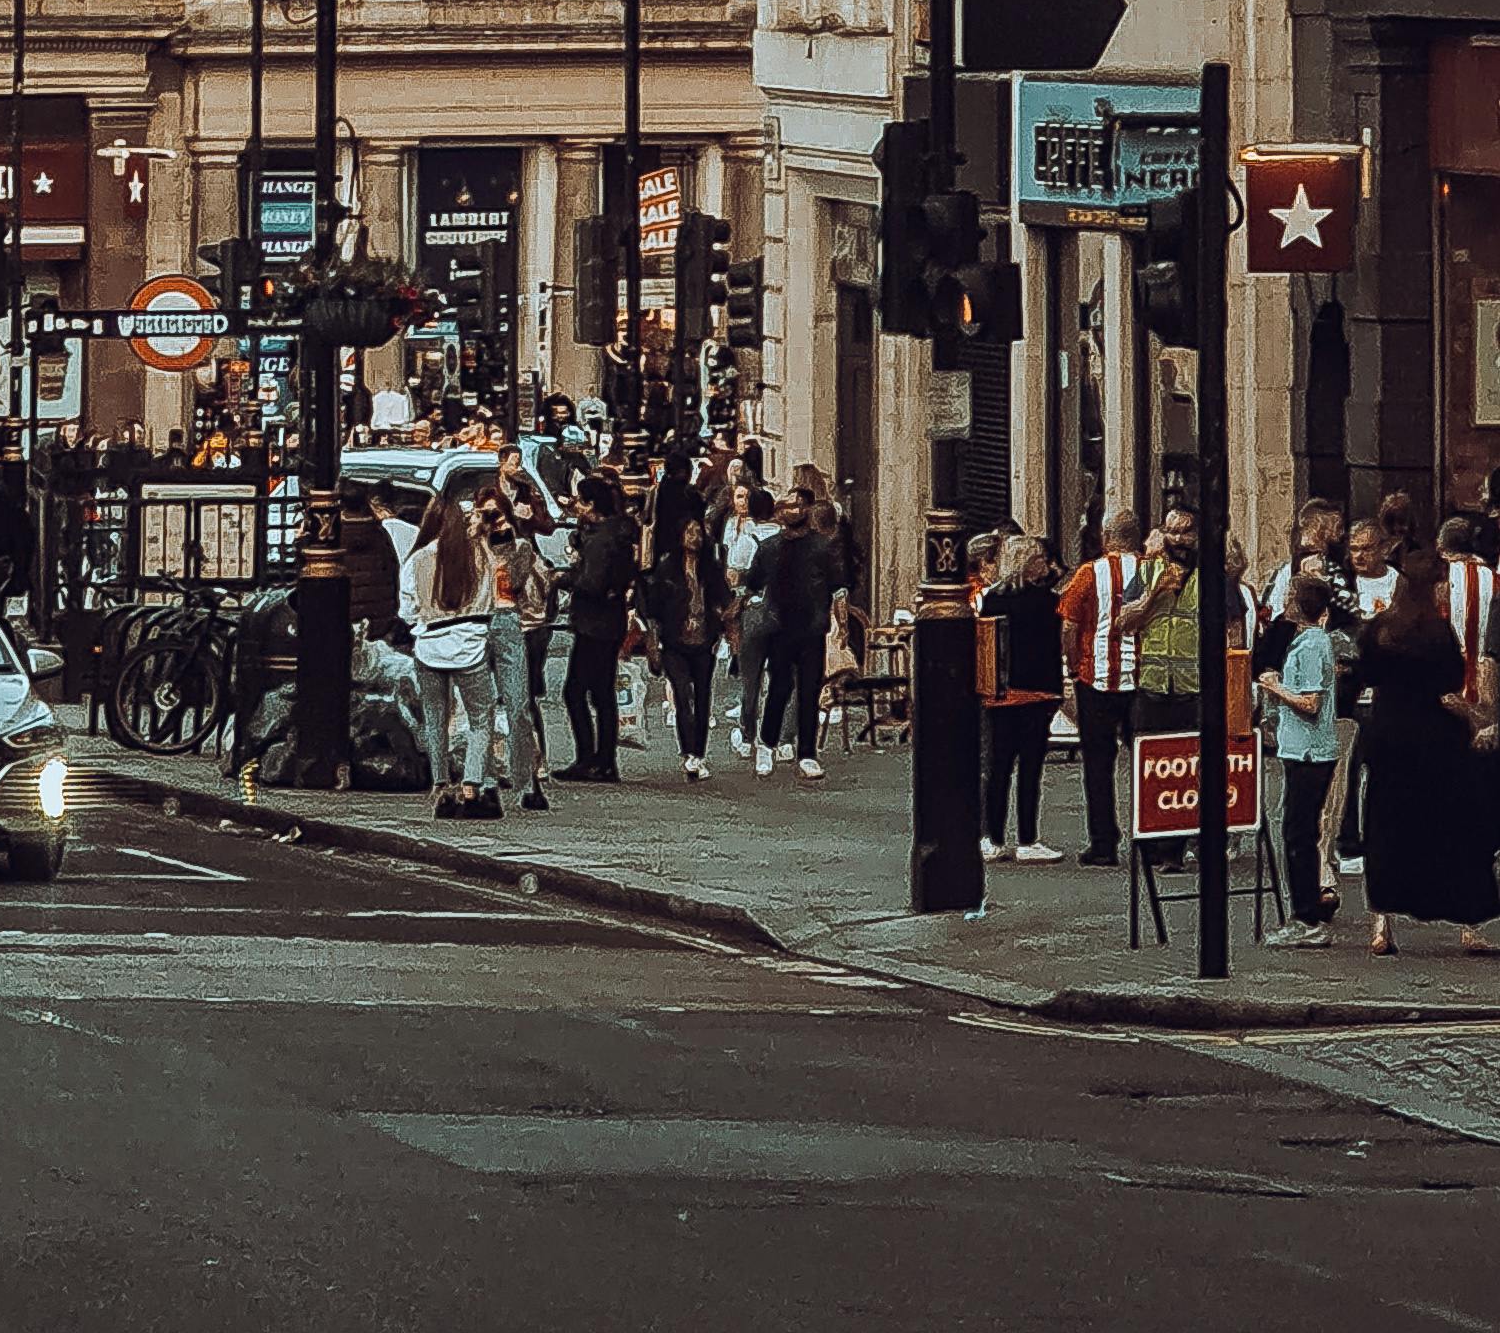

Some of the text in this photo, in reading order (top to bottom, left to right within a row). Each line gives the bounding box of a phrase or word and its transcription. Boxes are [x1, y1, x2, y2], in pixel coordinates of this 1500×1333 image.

[261, 181, 315, 194] HANGE
[639, 227, 678, 252] ALE
[1143, 752, 1253, 780] FOOTTH
[1157, 784, 1238, 810] CLOD
